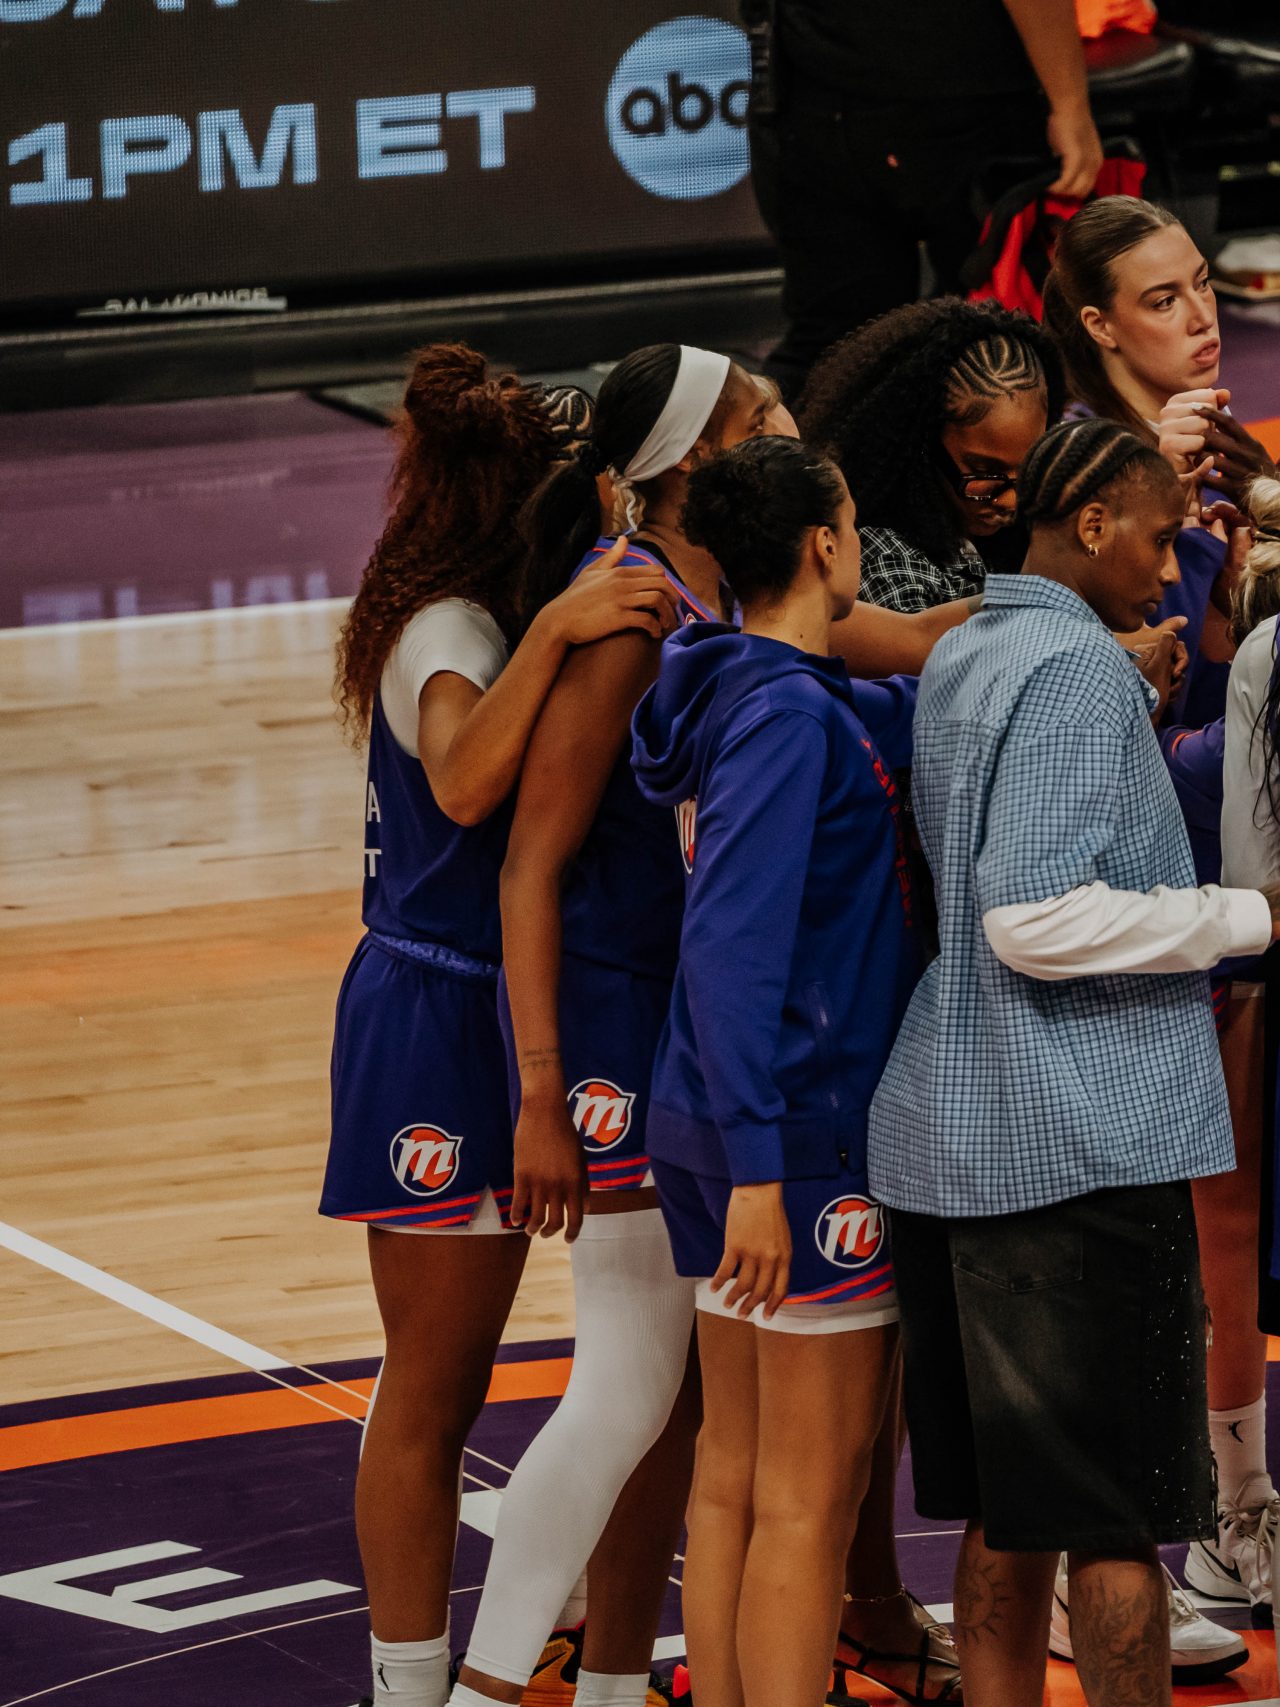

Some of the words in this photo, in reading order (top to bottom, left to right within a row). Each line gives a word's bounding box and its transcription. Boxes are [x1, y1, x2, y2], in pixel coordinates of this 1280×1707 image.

[8, 103, 317, 205] 1PM
[356, 86, 536, 178] ET
[621, 71, 750, 136] abc
